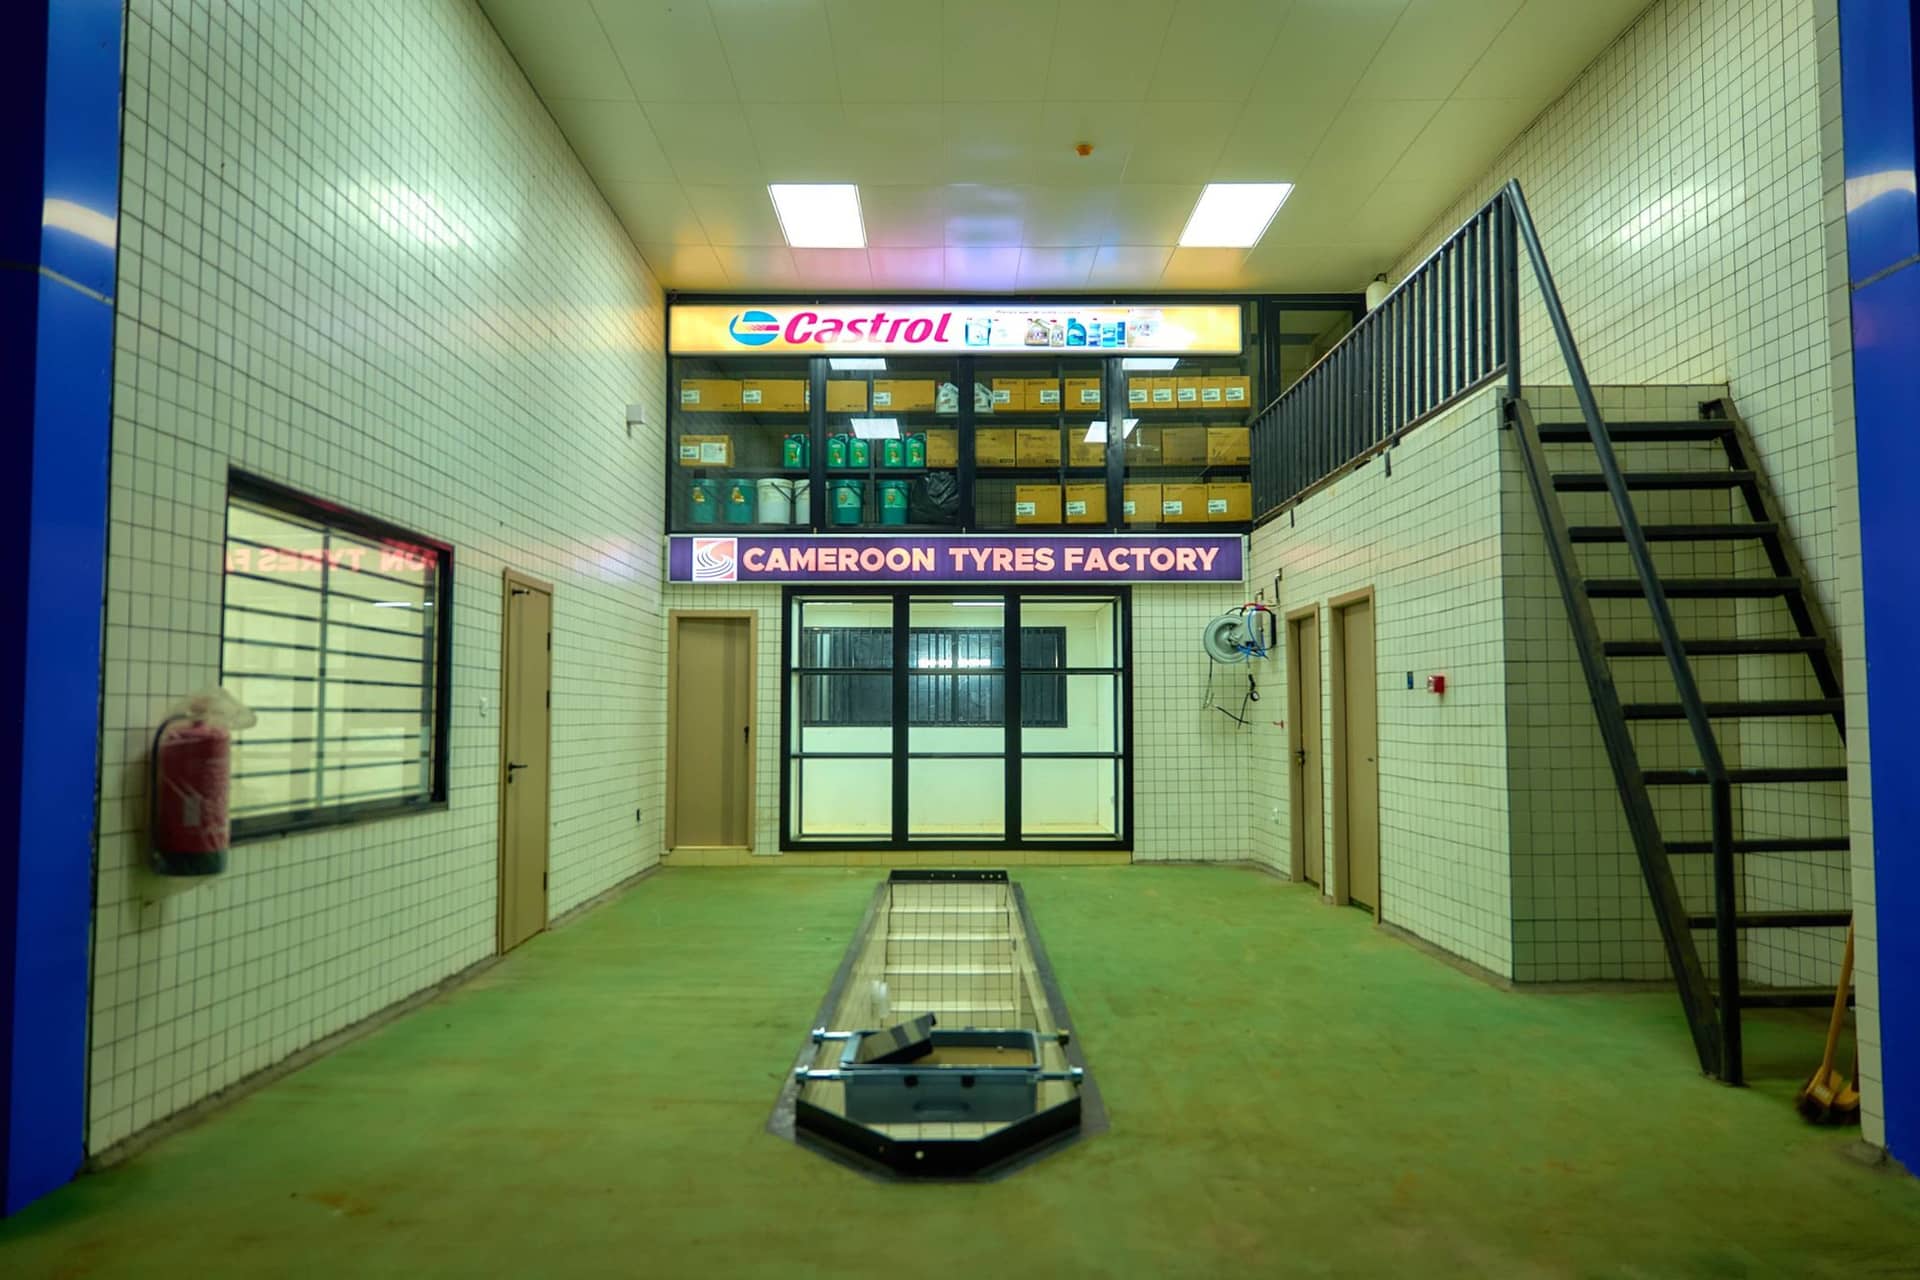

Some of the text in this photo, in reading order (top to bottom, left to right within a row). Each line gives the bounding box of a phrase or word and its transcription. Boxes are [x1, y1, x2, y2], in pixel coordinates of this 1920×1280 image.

[784, 312, 952, 344] Castrol
[742, 547, 1219, 572] CAMEROON TYRES FACTORY
